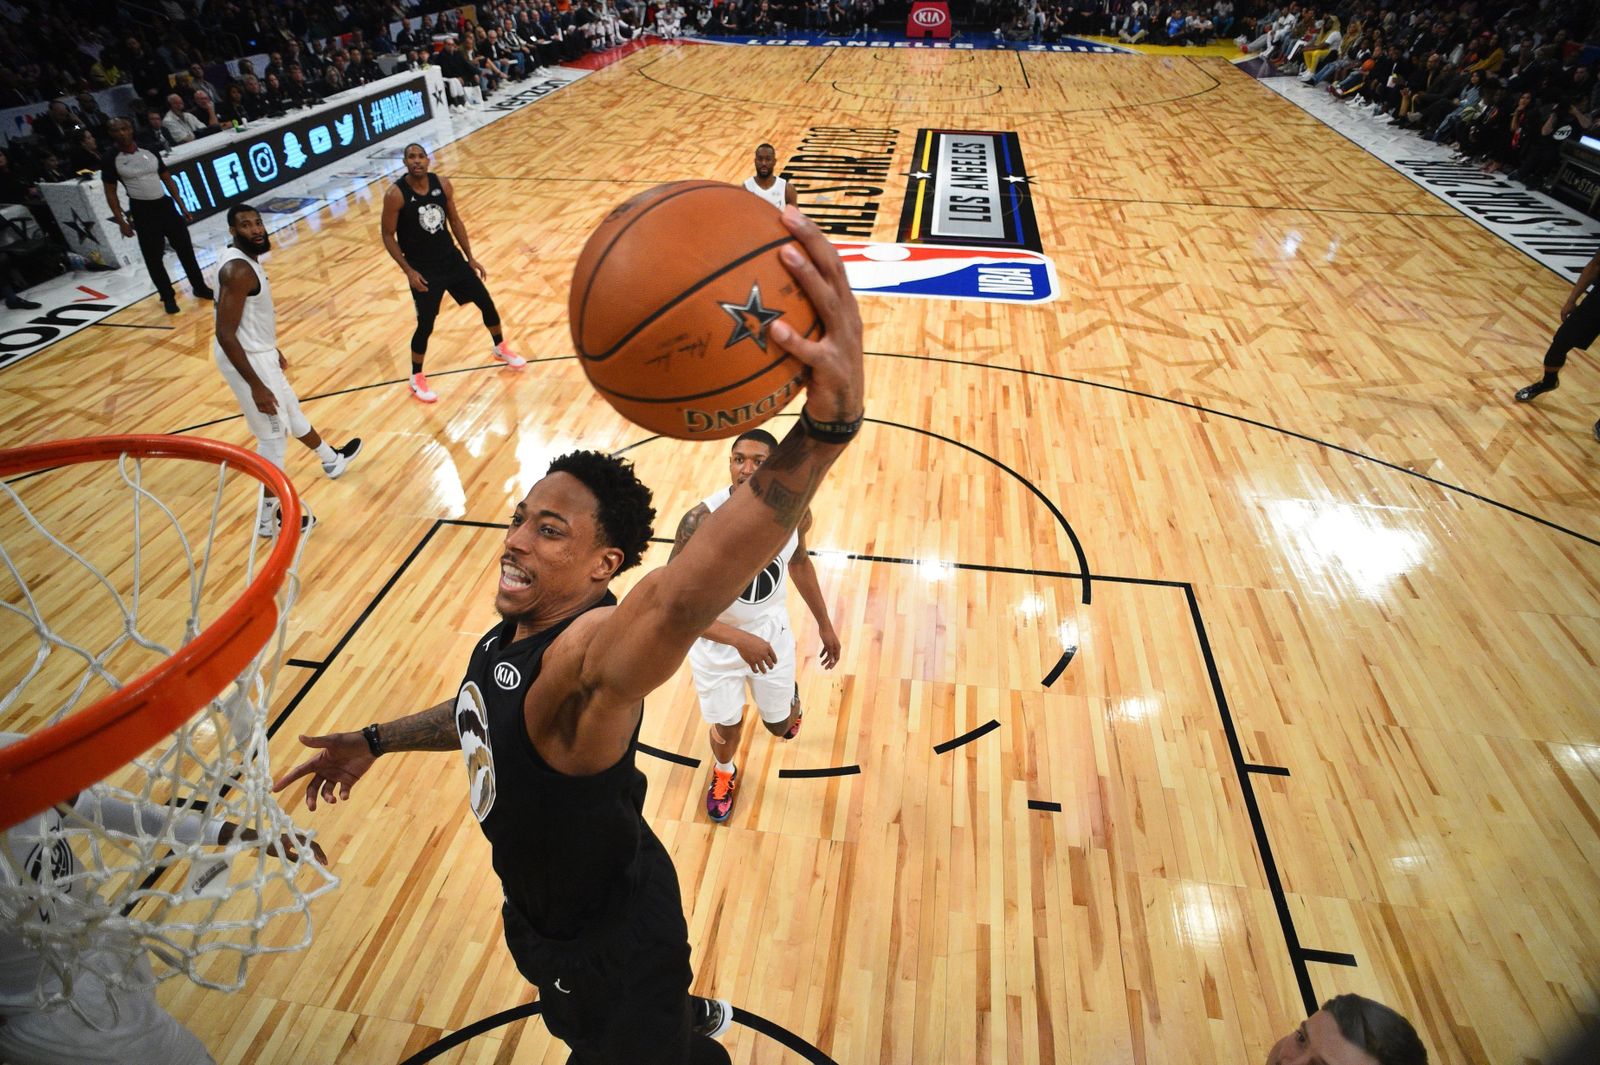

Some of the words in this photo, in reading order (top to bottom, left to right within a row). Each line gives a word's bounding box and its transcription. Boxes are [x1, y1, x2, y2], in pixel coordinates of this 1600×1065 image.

[918, 12, 940, 22] KIA
[822, 40, 975, 48] ANGELES
[1028, 44, 1114, 53] 2018
[482, 79, 572, 112] verizon
[950, 142, 989, 191] ANGELES
[948, 195, 991, 223] LOS
[977, 267, 1035, 296] NBA
[496, 666, 514, 686] KIA
